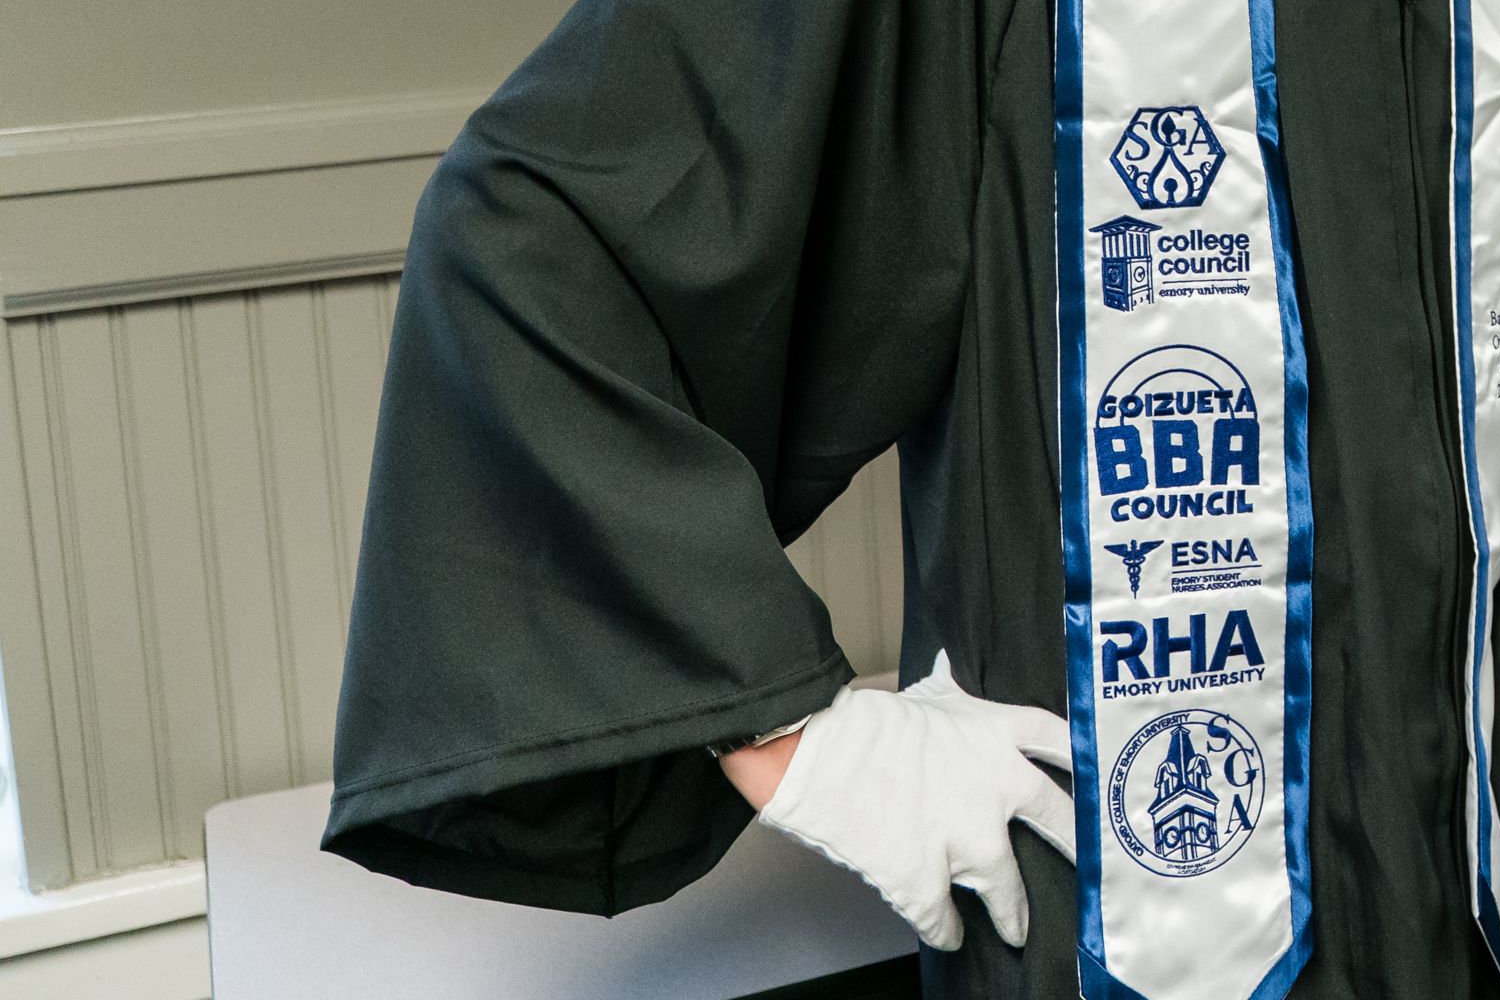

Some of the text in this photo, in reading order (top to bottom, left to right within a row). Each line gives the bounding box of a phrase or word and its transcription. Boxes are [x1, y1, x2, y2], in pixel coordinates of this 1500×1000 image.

[1124, 107, 1221, 162] SGA
[1157, 229, 1250, 256] college
[1158, 251, 1250, 275] council
[1159, 284, 1250, 298] emory university
[1098, 387, 1257, 419] GOIZUETA
[1093, 418, 1260, 496] BBA
[1110, 489, 1254, 522] COUNCIL
[1171, 538, 1258, 567] ESNA
[1171, 572, 1241, 586] EMORY STUDENT
[1206, 579, 1262, 591] ASSOCIATION
[1100, 609, 1265, 683] RHA
[1102, 667, 1266, 699] EMORY UNIVERSITY
[1112, 713, 1190, 857] OXFORD COLLEGE OF EMORY UNIVERSITY
